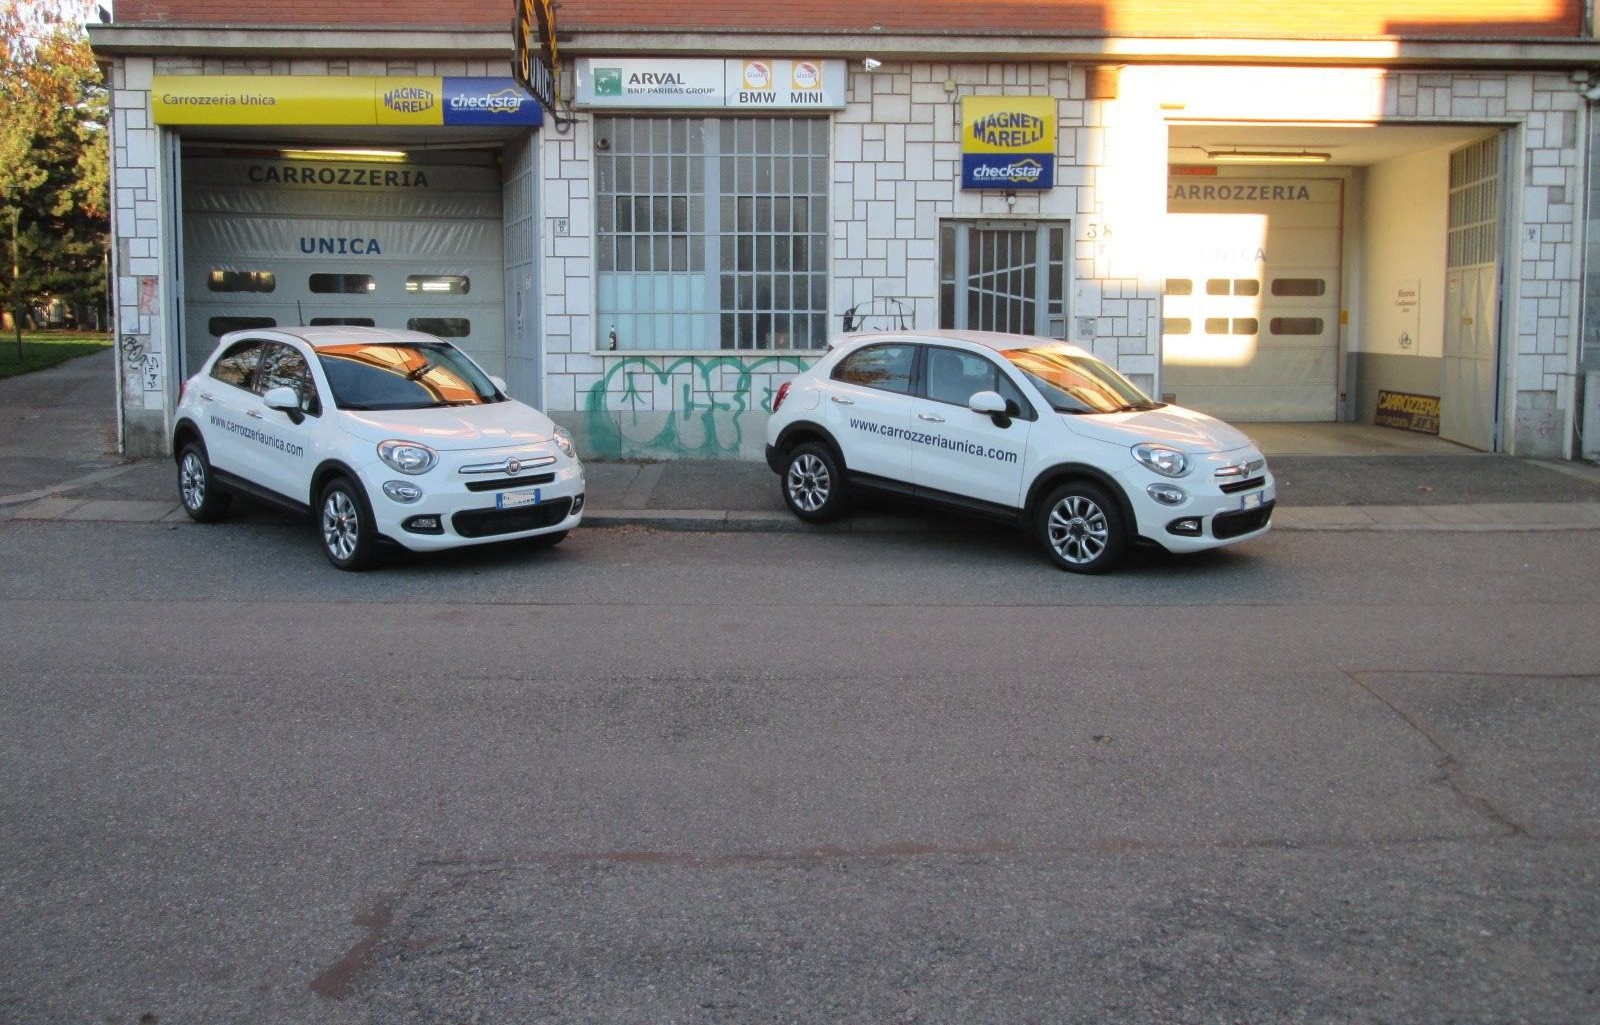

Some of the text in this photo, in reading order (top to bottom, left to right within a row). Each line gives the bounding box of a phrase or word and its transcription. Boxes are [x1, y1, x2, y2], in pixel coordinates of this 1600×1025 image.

[628, 72, 686, 85] ARVAL
[162, 93, 276, 106] Carrozzeria Unica
[384, 87, 434, 101] MAGNETI
[450, 93, 525, 108] checkstar
[739, 91, 777, 104] BMW
[790, 92, 823, 104] MINI
[384, 99, 434, 113] MARELLI
[973, 112, 1044, 131] MAGNETI
[973, 130, 1044, 147] MARELLI
[248, 164, 429, 187] CARROZZERIA
[973, 164, 1043, 178] checkstar
[299, 236, 382, 255] UNICA
[210, 414, 304, 458] www.carrozzeriaunica.com
[849, 416, 1018, 464] www.carrozzeriaunica.com
